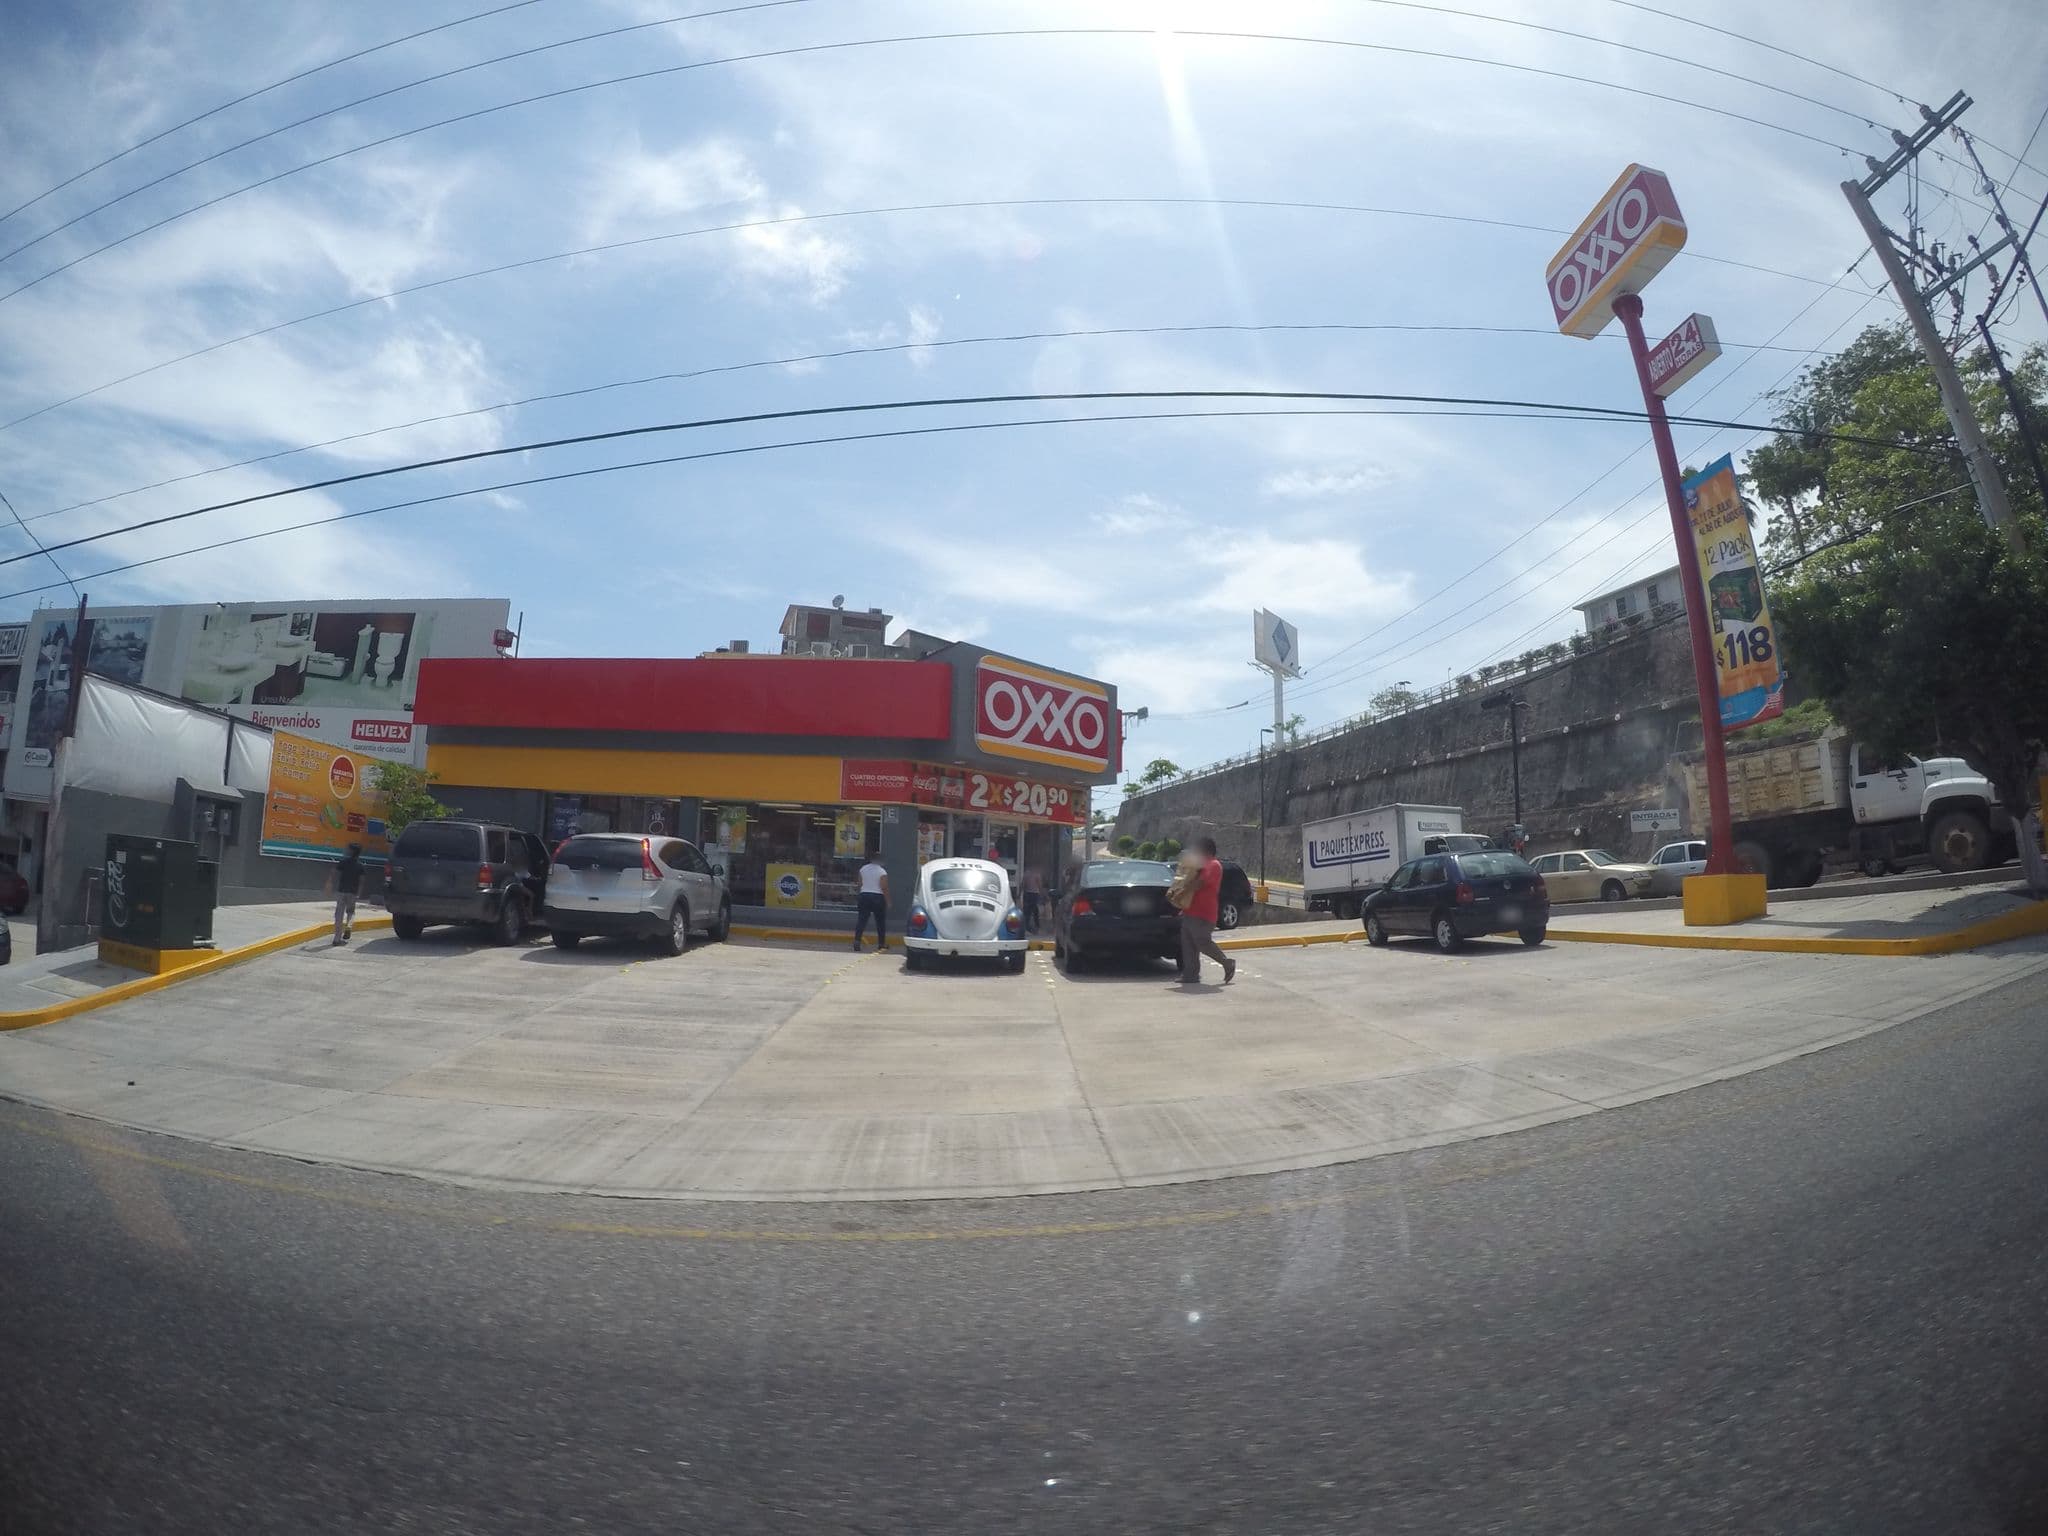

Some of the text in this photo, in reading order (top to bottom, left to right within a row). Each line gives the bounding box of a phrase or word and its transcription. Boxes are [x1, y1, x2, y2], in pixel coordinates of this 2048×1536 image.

[1554, 188, 1648, 311] OXXO
[1669, 318, 1701, 358] 24
[1648, 346, 1674, 383] ABIERTO
[1675, 341, 1703, 369] HORAS
[1703, 547, 1718, 566] 12
[1718, 532, 1751, 560] Pack
[251, 710, 321, 730] Bienvenidos
[985, 680, 1105, 750] OXXO
[355, 723, 409, 740] HELVEX
[1632, 812, 1671, 820] ENTRADA
[1320, 830, 1385, 857] PAQUETEXPRESS
